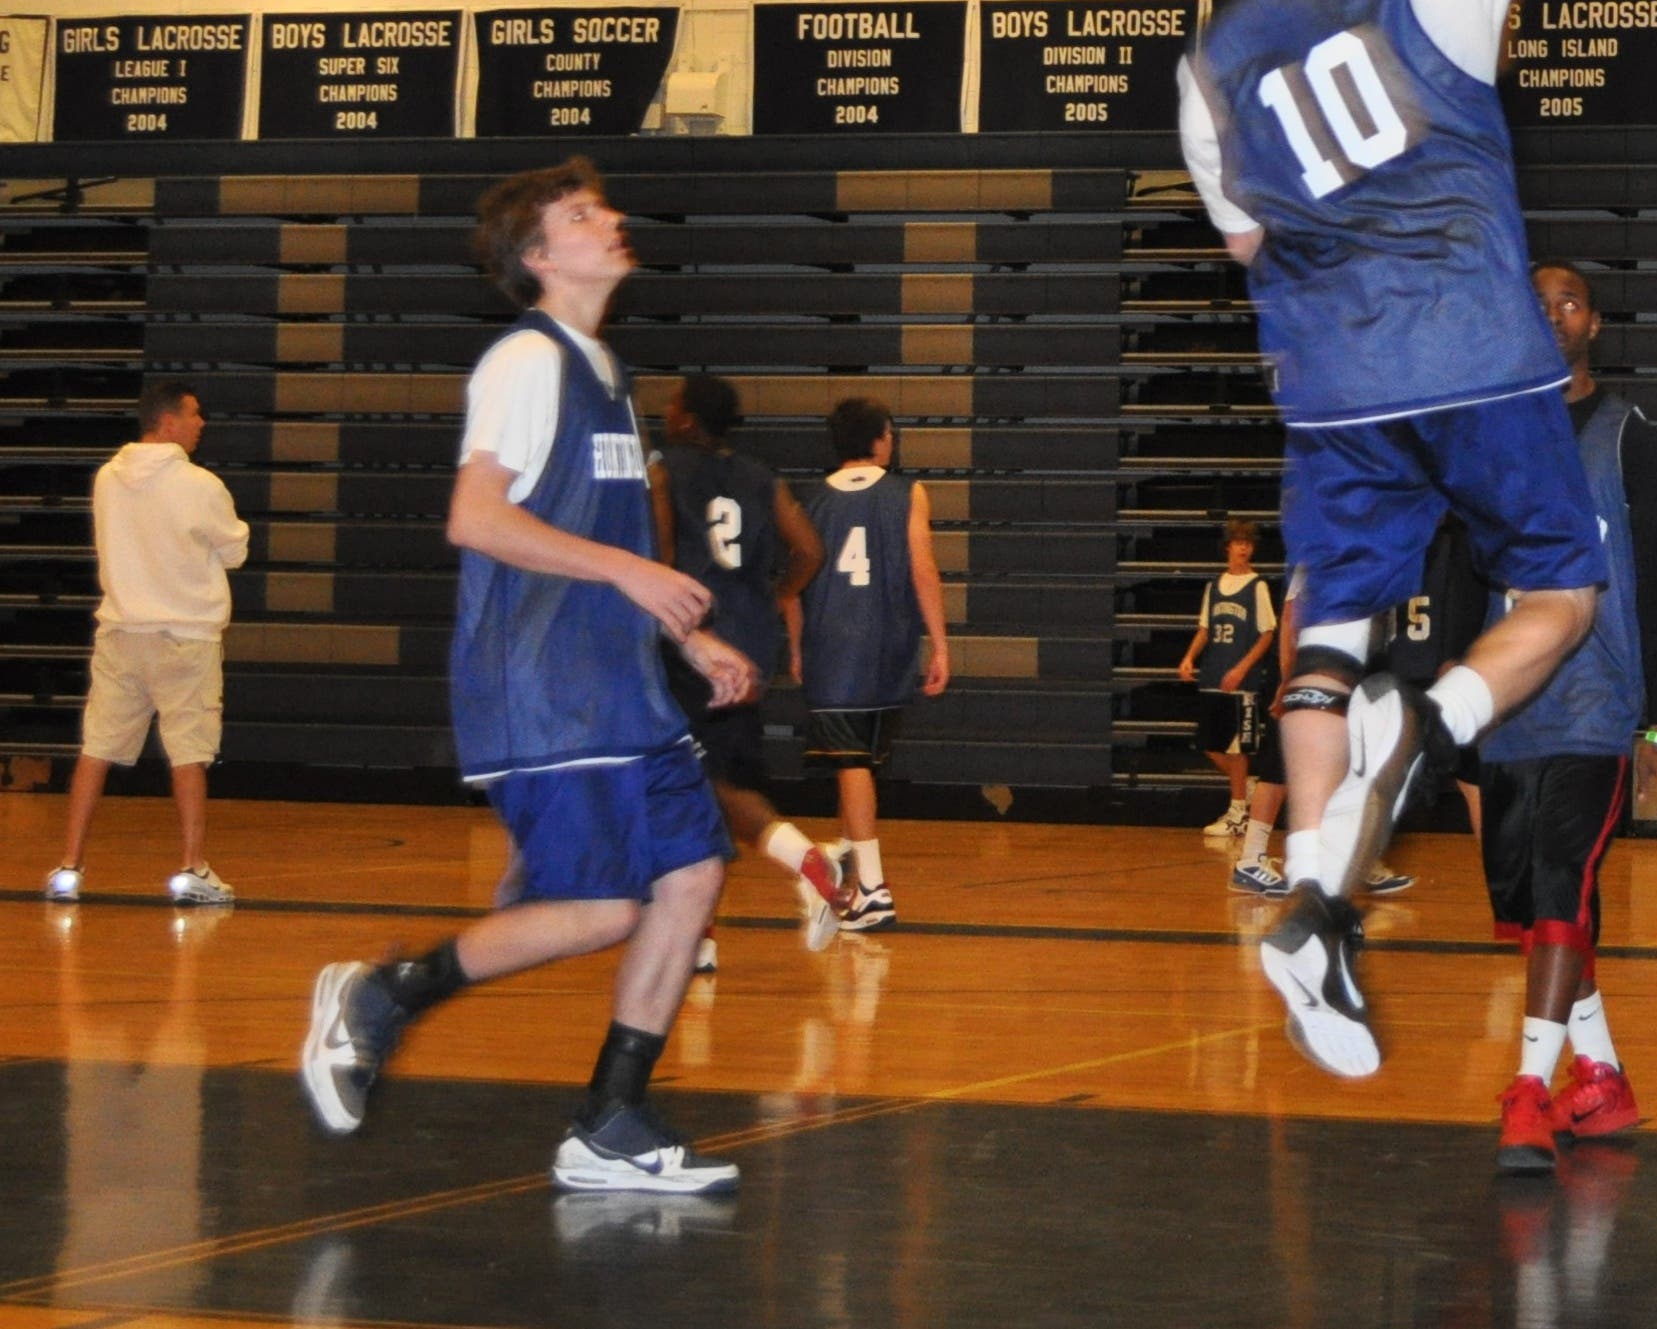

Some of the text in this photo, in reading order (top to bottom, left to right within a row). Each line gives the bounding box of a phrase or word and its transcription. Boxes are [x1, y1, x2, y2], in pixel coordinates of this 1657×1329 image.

[491, 17, 660, 45] GIRLS SOCCER
[799, 12, 920, 40] FOOTBALL
[992, 9, 1186, 38] BOYS LACROSSE
[63, 24, 243, 53] GIRLS LACROSSE
[272, 21, 452, 49] BOYS LACROSSE
[1044, 47, 1106, 65] DIVISION
[1508, 39, 1618, 58] LONG ISLAND
[319, 57, 399, 76] SUPER SIX
[546, 53, 601, 71] COUNTY
[828, 49, 892, 68] DIVISION
[115, 60, 168, 78] LEAGUE
[1519, 69, 1605, 88] CHAMPIONS
[533, 80, 611, 99] CHAMPIONS
[817, 77, 899, 96] CHAMPIONS
[1046, 75, 1129, 94] CHAMPIONS
[112, 87, 187, 105] CHAMPIONS
[320, 85, 398, 104] CHAMPIONS
[551, 107, 591, 126] 2004
[836, 106, 878, 124] 2004
[1065, 104, 1108, 122] 2005
[1258, 31, 1407, 199] 10
[1539, 98, 1583, 117] 2005
[127, 114, 167, 132] 2004
[336, 112, 378, 130] 2004
[706, 496, 741, 569] 2
[837, 526, 870, 586] 4
